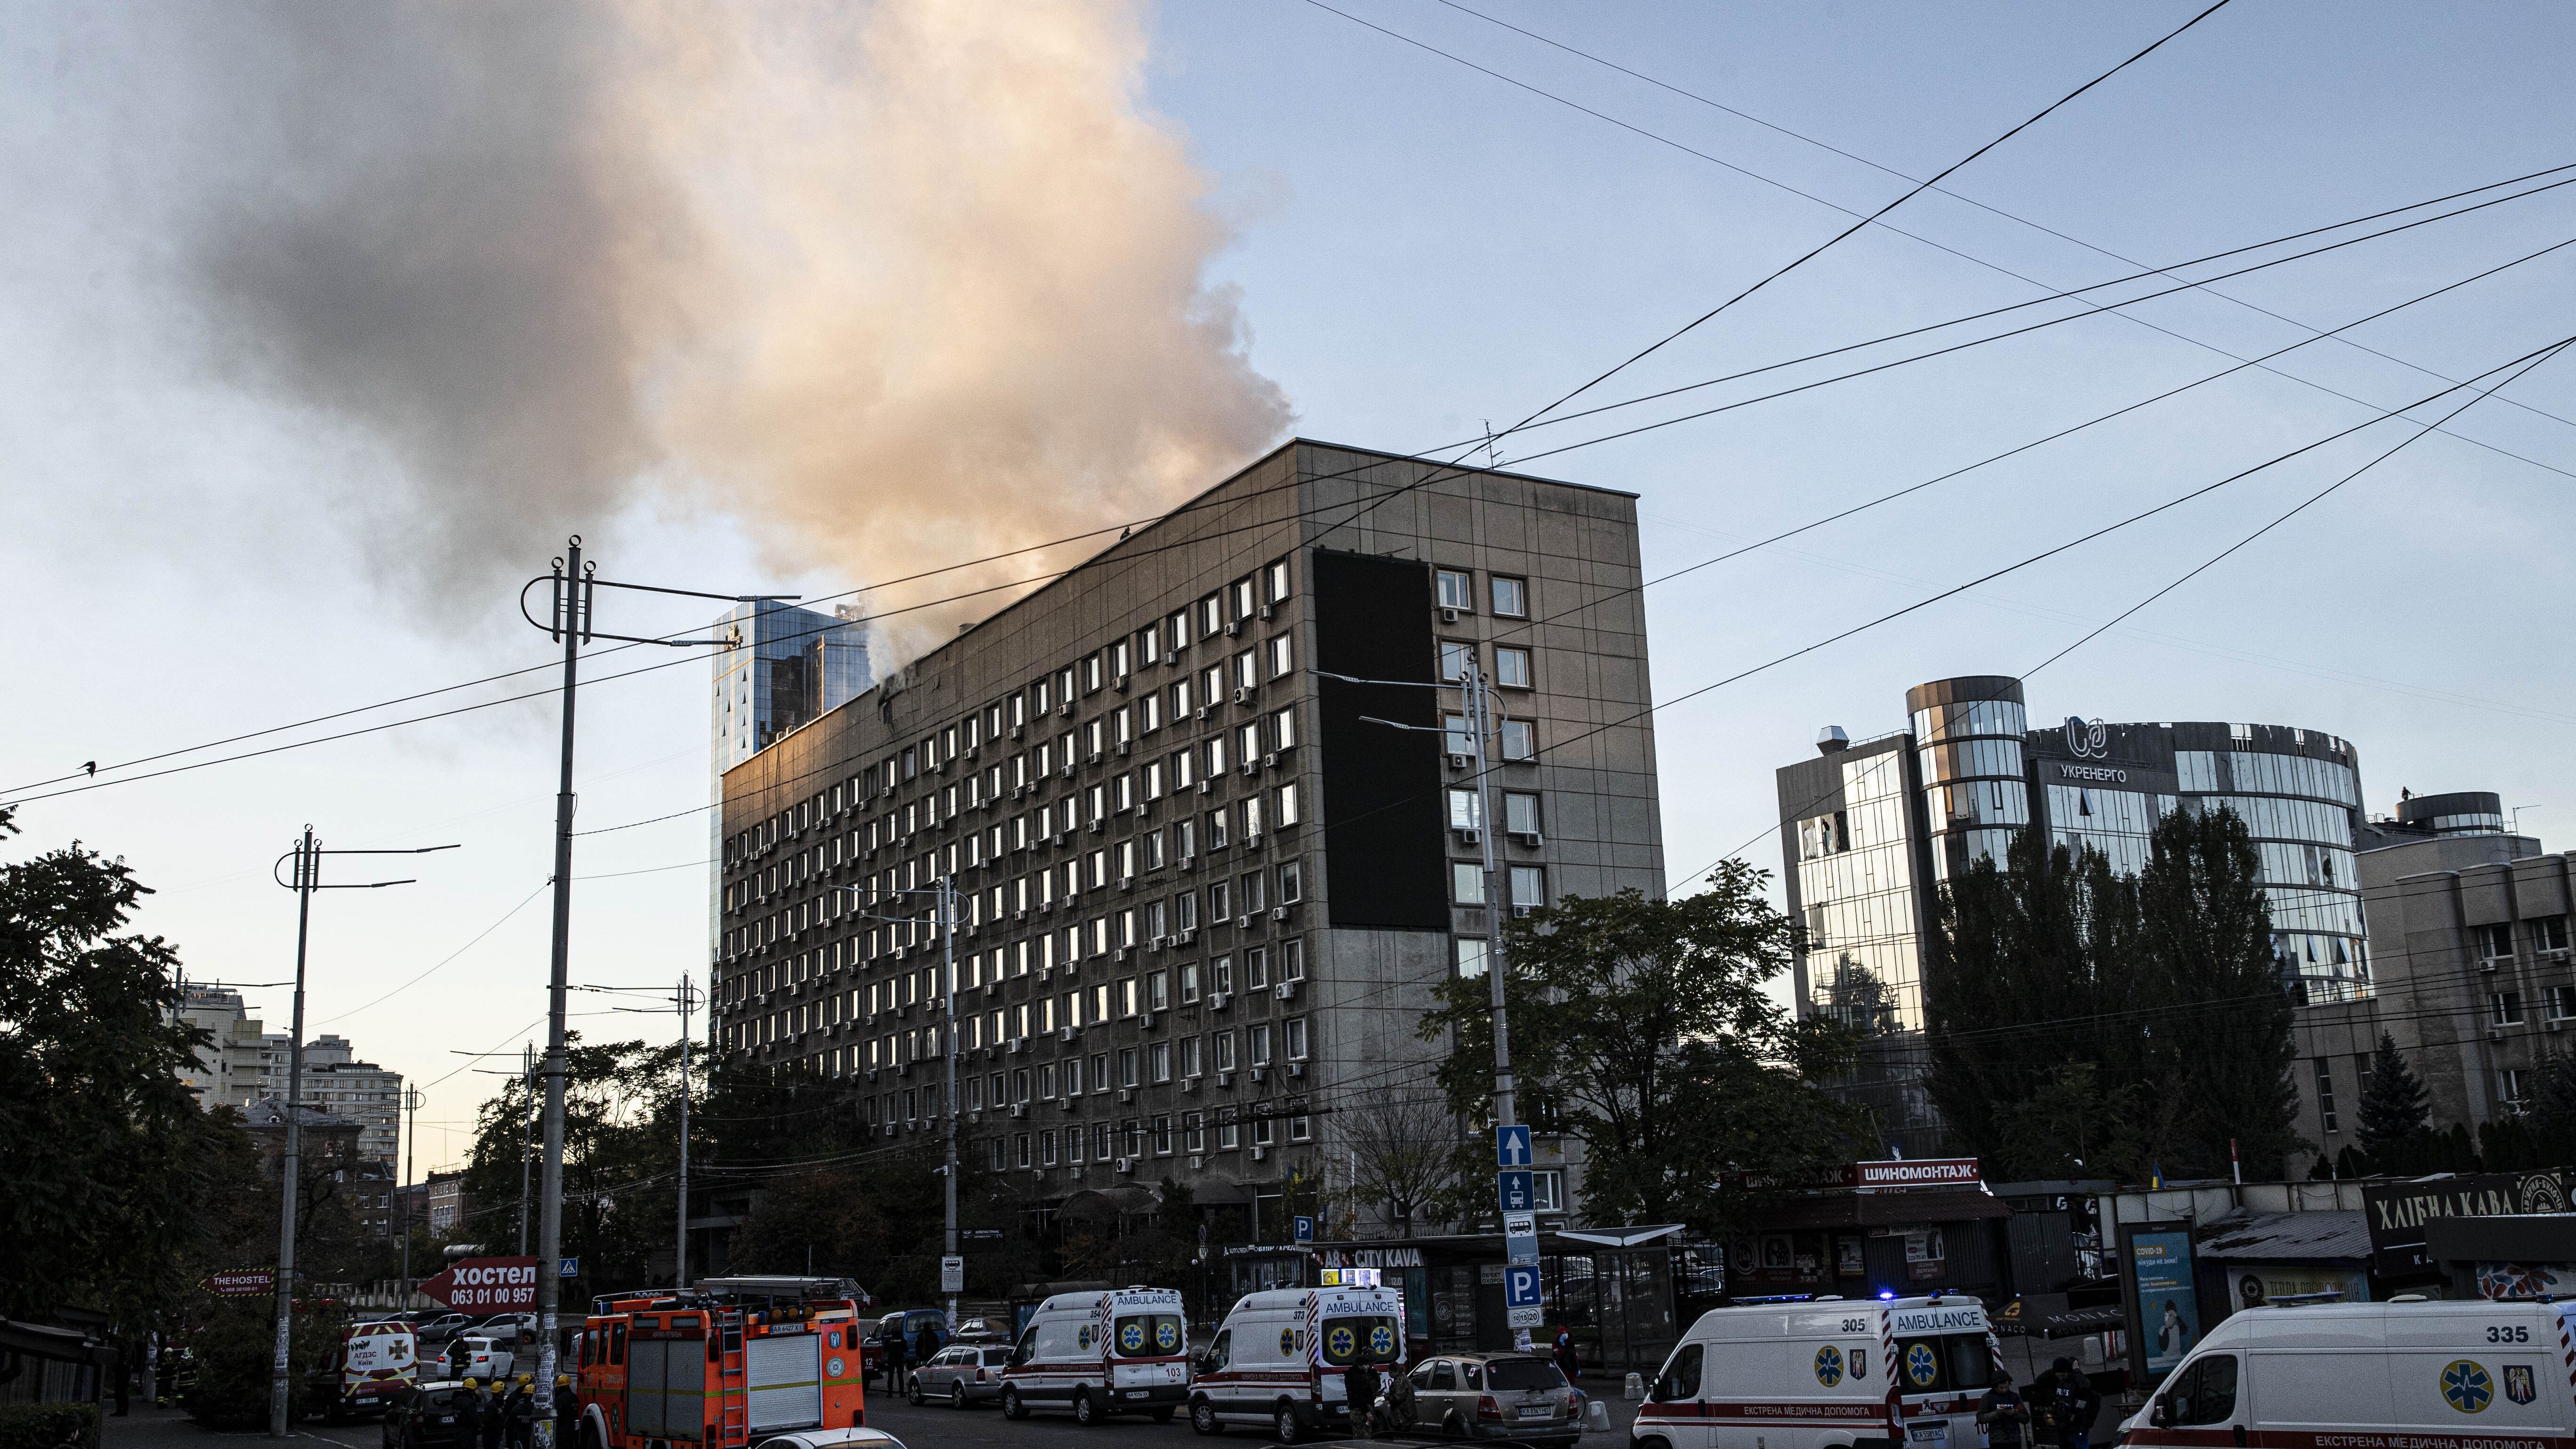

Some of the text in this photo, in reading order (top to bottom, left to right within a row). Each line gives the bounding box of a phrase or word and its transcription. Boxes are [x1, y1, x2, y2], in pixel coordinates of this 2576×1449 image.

[2061, 764, 2126, 782] УКРЕНЕРГО
[1865, 1164, 1972, 1181] ШИНОМОНТАЖ
[2376, 1189, 2514, 1230] ХЛІБНА КАВА
[1355, 1248, 1421, 1267] CITY KAVA
[232, 1276, 271, 1284] HOSTEL
[1513, 1272, 1532, 1302] P
[451, 1288, 535, 1305] 063 01 00 957
[1118, 1295, 1177, 1305] AMBULANCE
[1090, 1310, 1101, 1318] 354
[1326, 1302, 1394, 1313] AMBULANCE
[1293, 1311, 1305, 1320] 373
[1898, 1312, 1980, 1330] AMBULANCE
[2047, 1309, 2124, 1324] MONAC
[1842, 1319, 1865, 1332] 305
[1993, 1325, 2025, 1333] ONACO
[2487, 1326, 2528, 1343] 335
[1166, 1368, 1181, 1377] 103
[1744, 1406, 1870, 1417] ЕКСТРЕНА МЕДИЧНА ДОПОМОГА
[2315, 1436, 2545, 1449] ЕКСТРЕНА МЕДИЧНА ДОПОМОГА
